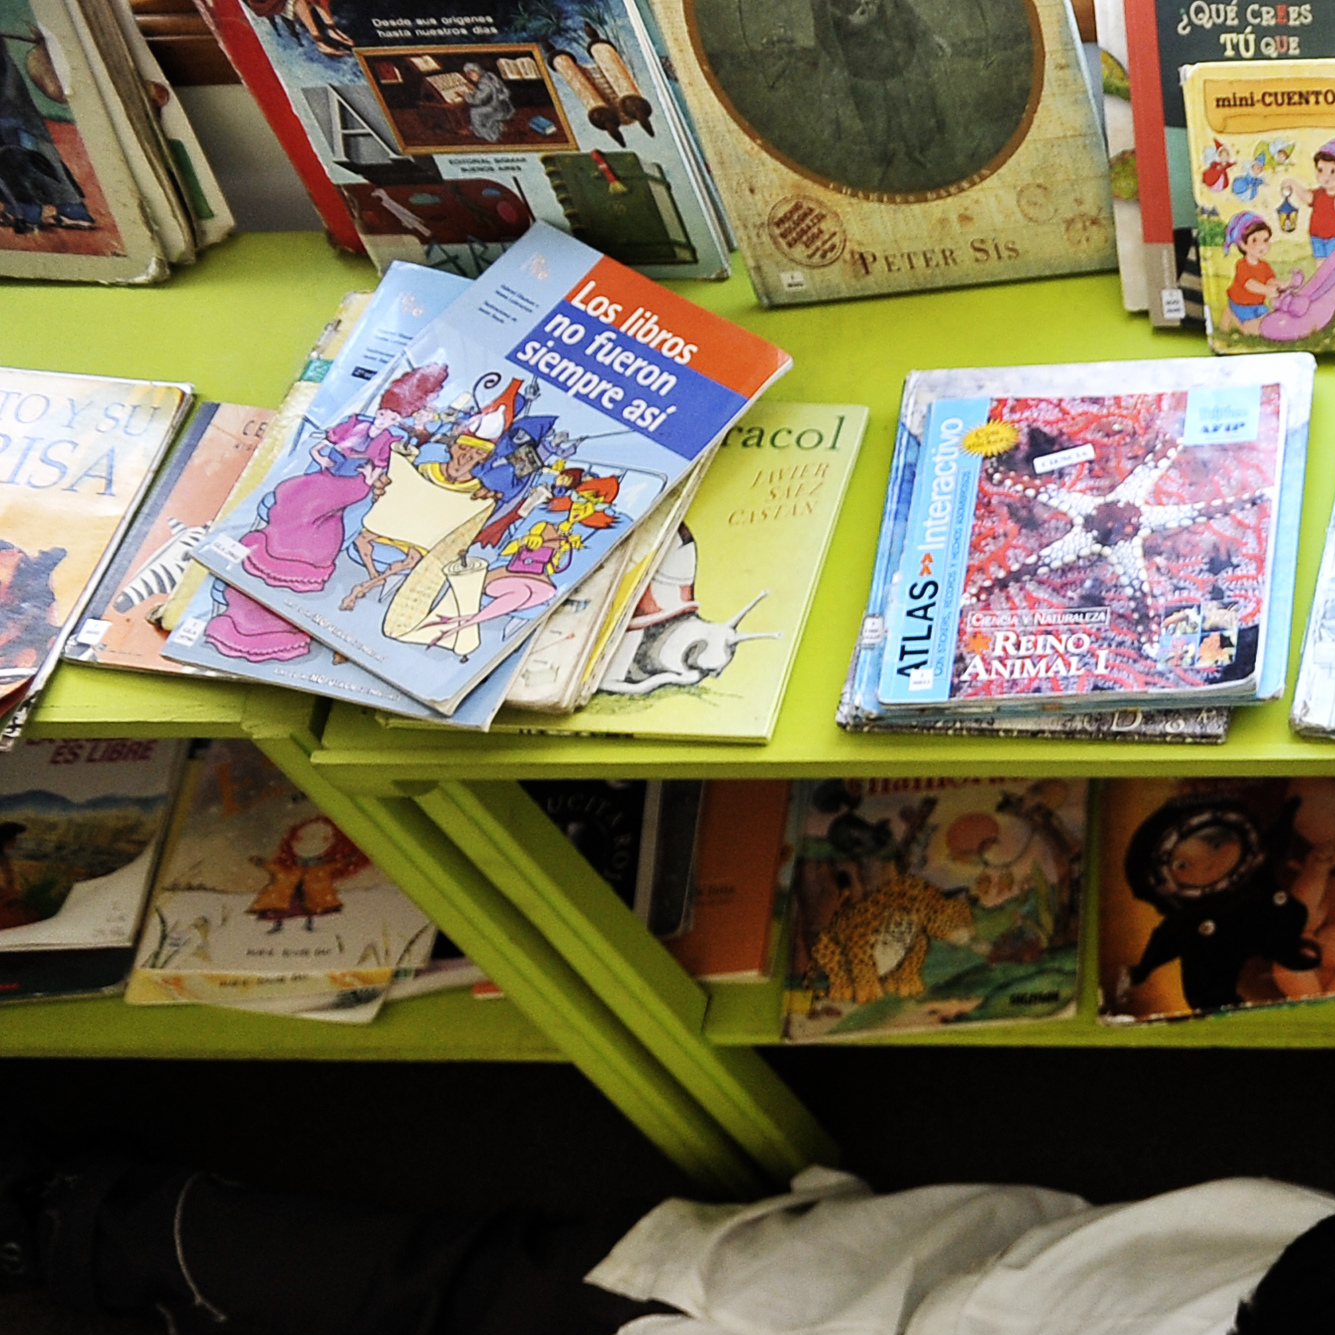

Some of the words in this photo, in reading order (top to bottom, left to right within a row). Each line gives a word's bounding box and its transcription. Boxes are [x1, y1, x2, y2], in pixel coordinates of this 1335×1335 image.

[1247, 3, 1313, 27] CREES
[377, 28, 411, 38] hasta
[415, 27, 468, 37] nuestros
[1219, 31, 1256, 58] TÚ
[1260, 37, 1301, 57] QUE
[858, 248, 958, 276] PETER
[569, 280, 622, 325] Los
[618, 308, 698, 365] libros
[544, 312, 585, 346] no
[585, 331, 677, 397] fueron
[516, 340, 625, 410] siempre
[57, 395, 89, 429] Y
[97, 402, 161, 437] SU
[720, 415, 846, 452] racol
[923, 417, 964, 551] Interactivo
[896, 579, 939, 679] ATLAS
[991, 632, 1091, 656] REINO
[960, 655, 1084, 681] ANIMAL
[49, 742, 82, 765] ES
[86, 738, 153, 762] LIBRE
